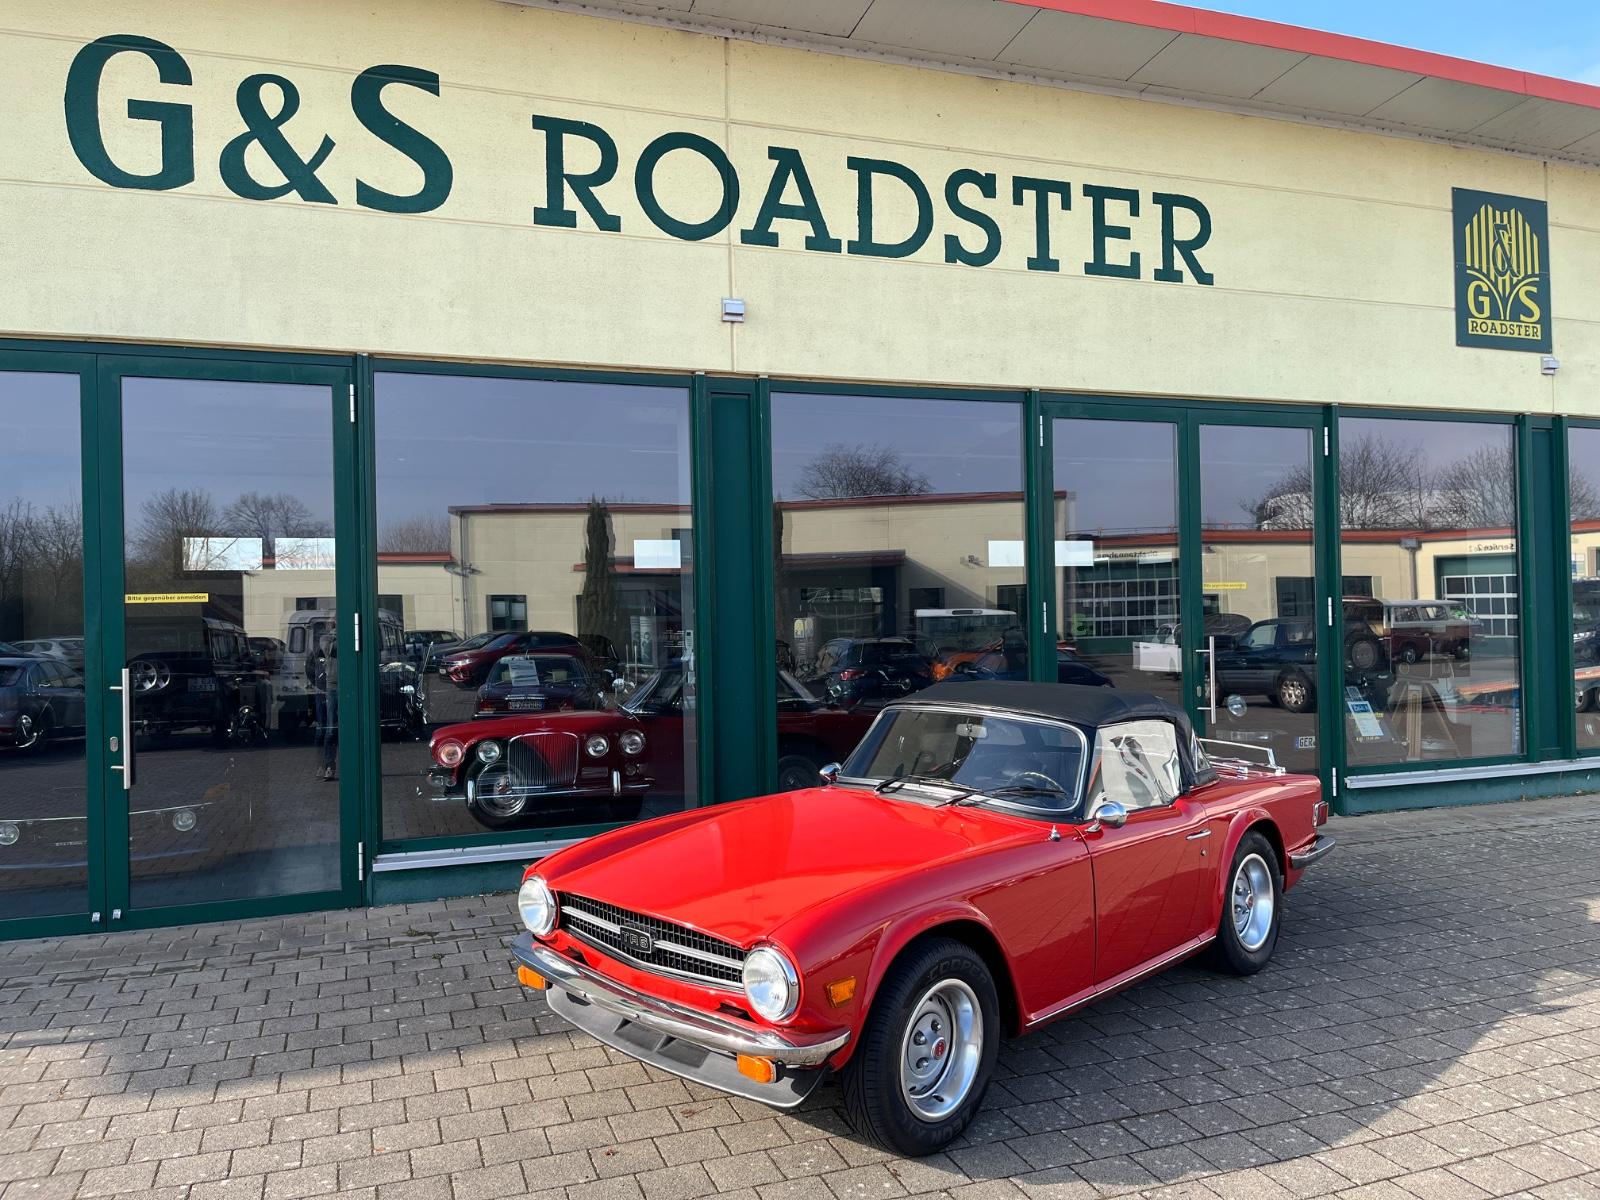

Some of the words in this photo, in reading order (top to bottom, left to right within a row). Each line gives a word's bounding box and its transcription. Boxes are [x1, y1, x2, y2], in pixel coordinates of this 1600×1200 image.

[64, 33, 454, 214] G&S
[531, 113, 1215, 286] ROADSTER
[1470, 319, 1540, 338] ROADSTER
[177, 593, 207, 601] anmelden
[1299, 737, 1313, 748] GER
[621, 930, 649, 949] TR6
